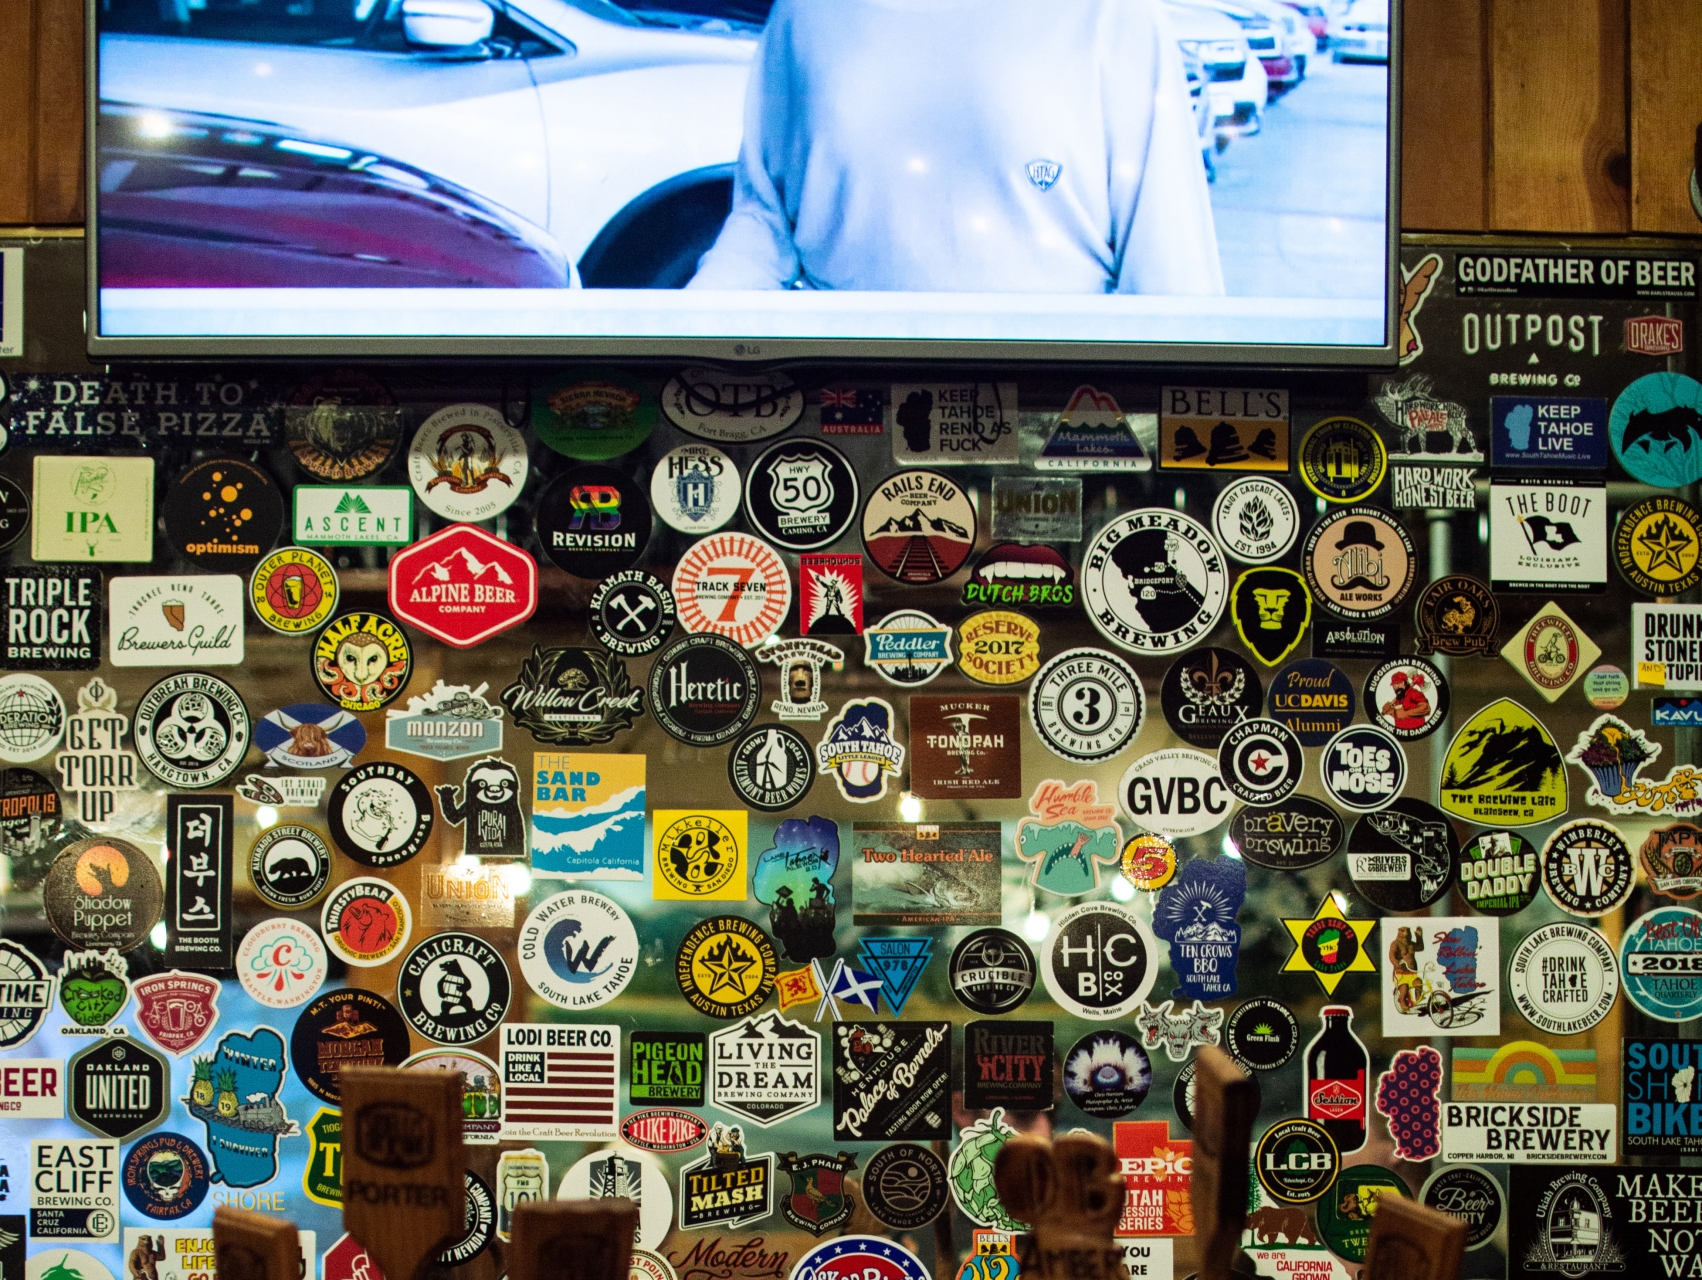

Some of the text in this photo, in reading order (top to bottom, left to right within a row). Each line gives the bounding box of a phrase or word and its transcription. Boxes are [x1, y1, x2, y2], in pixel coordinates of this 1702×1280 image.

[1459, 257, 1695, 286] GODFATHER OF BEER
[1464, 313, 1603, 355] OUTPOST
[53, 381, 243, 405] DEATH TO
[1170, 389, 1282, 418] BELL'S
[939, 405, 995, 418] TAHOE
[26, 412, 271, 436] FALSE PIZZA
[698, 423, 716, 436] Fort
[750, 425, 766, 436] CA
[939, 439, 982, 451] FUCK
[1057, 431, 1130, 443] Mammoth
[1538, 438, 1573, 450] LIVE
[668, 454, 723, 479] HESS
[1048, 459, 1137, 468] CALIFORNIA
[783, 479, 821, 501] 50
[1505, 492, 1591, 518] THE BOOT
[65, 511, 119, 534] IPA
[781, 514, 828, 525] BREWERY
[552, 532, 636, 548] REVISION
[5, 577, 91, 606] TRIPLE
[1631, 570, 1699, 594] AUSTIN TEXAS
[410, 584, 516, 604] ALPINE BEER
[1339, 593, 1382, 601] ALE WORKS
[7, 608, 91, 644] ROCK
[1097, 607, 1214, 649] BREWING
[316, 614, 408, 663] HALF ACRE
[600, 630, 661, 654] BREWING
[875, 634, 940, 652] Peddler
[7, 647, 91, 659] BREWING
[965, 650, 1036, 676] SOCIETY
[1050, 661, 1128, 693] THREE MILE
[1287, 668, 1334, 690] Proud
[340, 699, 381, 711] CHICAGO
[506, 686, 645, 714] Willow Creek
[940, 704, 990, 712] MUCKER
[927, 735, 1004, 749] TONOPAH
[1047, 723, 1128, 750] BREWING CO.
[1229, 724, 1289, 745] CHAPMAN
[281, 754, 338, 768] SCOTLAND
[538, 755, 570, 770] THE
[820, 741, 902, 763] SOUTH TAHOE
[537, 772, 600, 786] SAND
[1331, 771, 1395, 794] NOSE
[537, 786, 587, 801] BAR
[1034, 784, 1096, 812] Humble
[1127, 777, 1228, 816] GVBC
[81, 790, 115, 823] UP
[661, 819, 735, 853] Mikkeller
[1556, 828, 1619, 850] WIMBERLEY
[182, 811, 216, 922] 더부스
[566, 856, 640, 866] Capitola California
[862, 848, 994, 863] Two Hearted Ale
[1461, 854, 1536, 881] DOUBLE
[1467, 876, 1533, 900] DADDY
[73, 895, 132, 910] Shadow
[73, 910, 132, 931] Puppet
[523, 894, 621, 960] COLD WATER BREWERY
[410, 940, 497, 977] CALICRAFT
[1179, 945, 1233, 958] TEN CROWS
[1193, 958, 1218, 973] BBQ
[960, 972, 1026, 984] CRUCIBLE
[412, 1014, 488, 1042] BREWING
[506, 1028, 614, 1048] LODI BEER CO.
[632, 1042, 703, 1060] PIGEON
[973, 1027, 1045, 1054] RIVER
[86, 1063, 149, 1071] OAKLAND
[509, 1073, 541, 1082] LOCAL
[988, 1055, 1043, 1082] CITY
[717, 1072, 813, 1088] DREAM
[86, 1074, 150, 1110] UNITED
[648, 1086, 700, 1098] BREWERY
[1449, 1106, 1582, 1127] BRICKSIDE
[1486, 1129, 1611, 1151] BREWERY
[37, 1145, 114, 1168] EAST
[868, 1149, 944, 1184] SOUTH OF NORTH
[1265, 1152, 1332, 1171] LCB
[35, 1170, 113, 1194] CLIFF
[689, 1167, 765, 1195] TILTED
[37, 1196, 114, 1206] BREWING CO.
[211, 1190, 286, 1211] SHORE
[690, 1182, 763, 1212] MASH
[1535, 1171, 1613, 1219] Ukiah Brewing Company
[1276, 1261, 1333, 1272] CALIFORNIA
